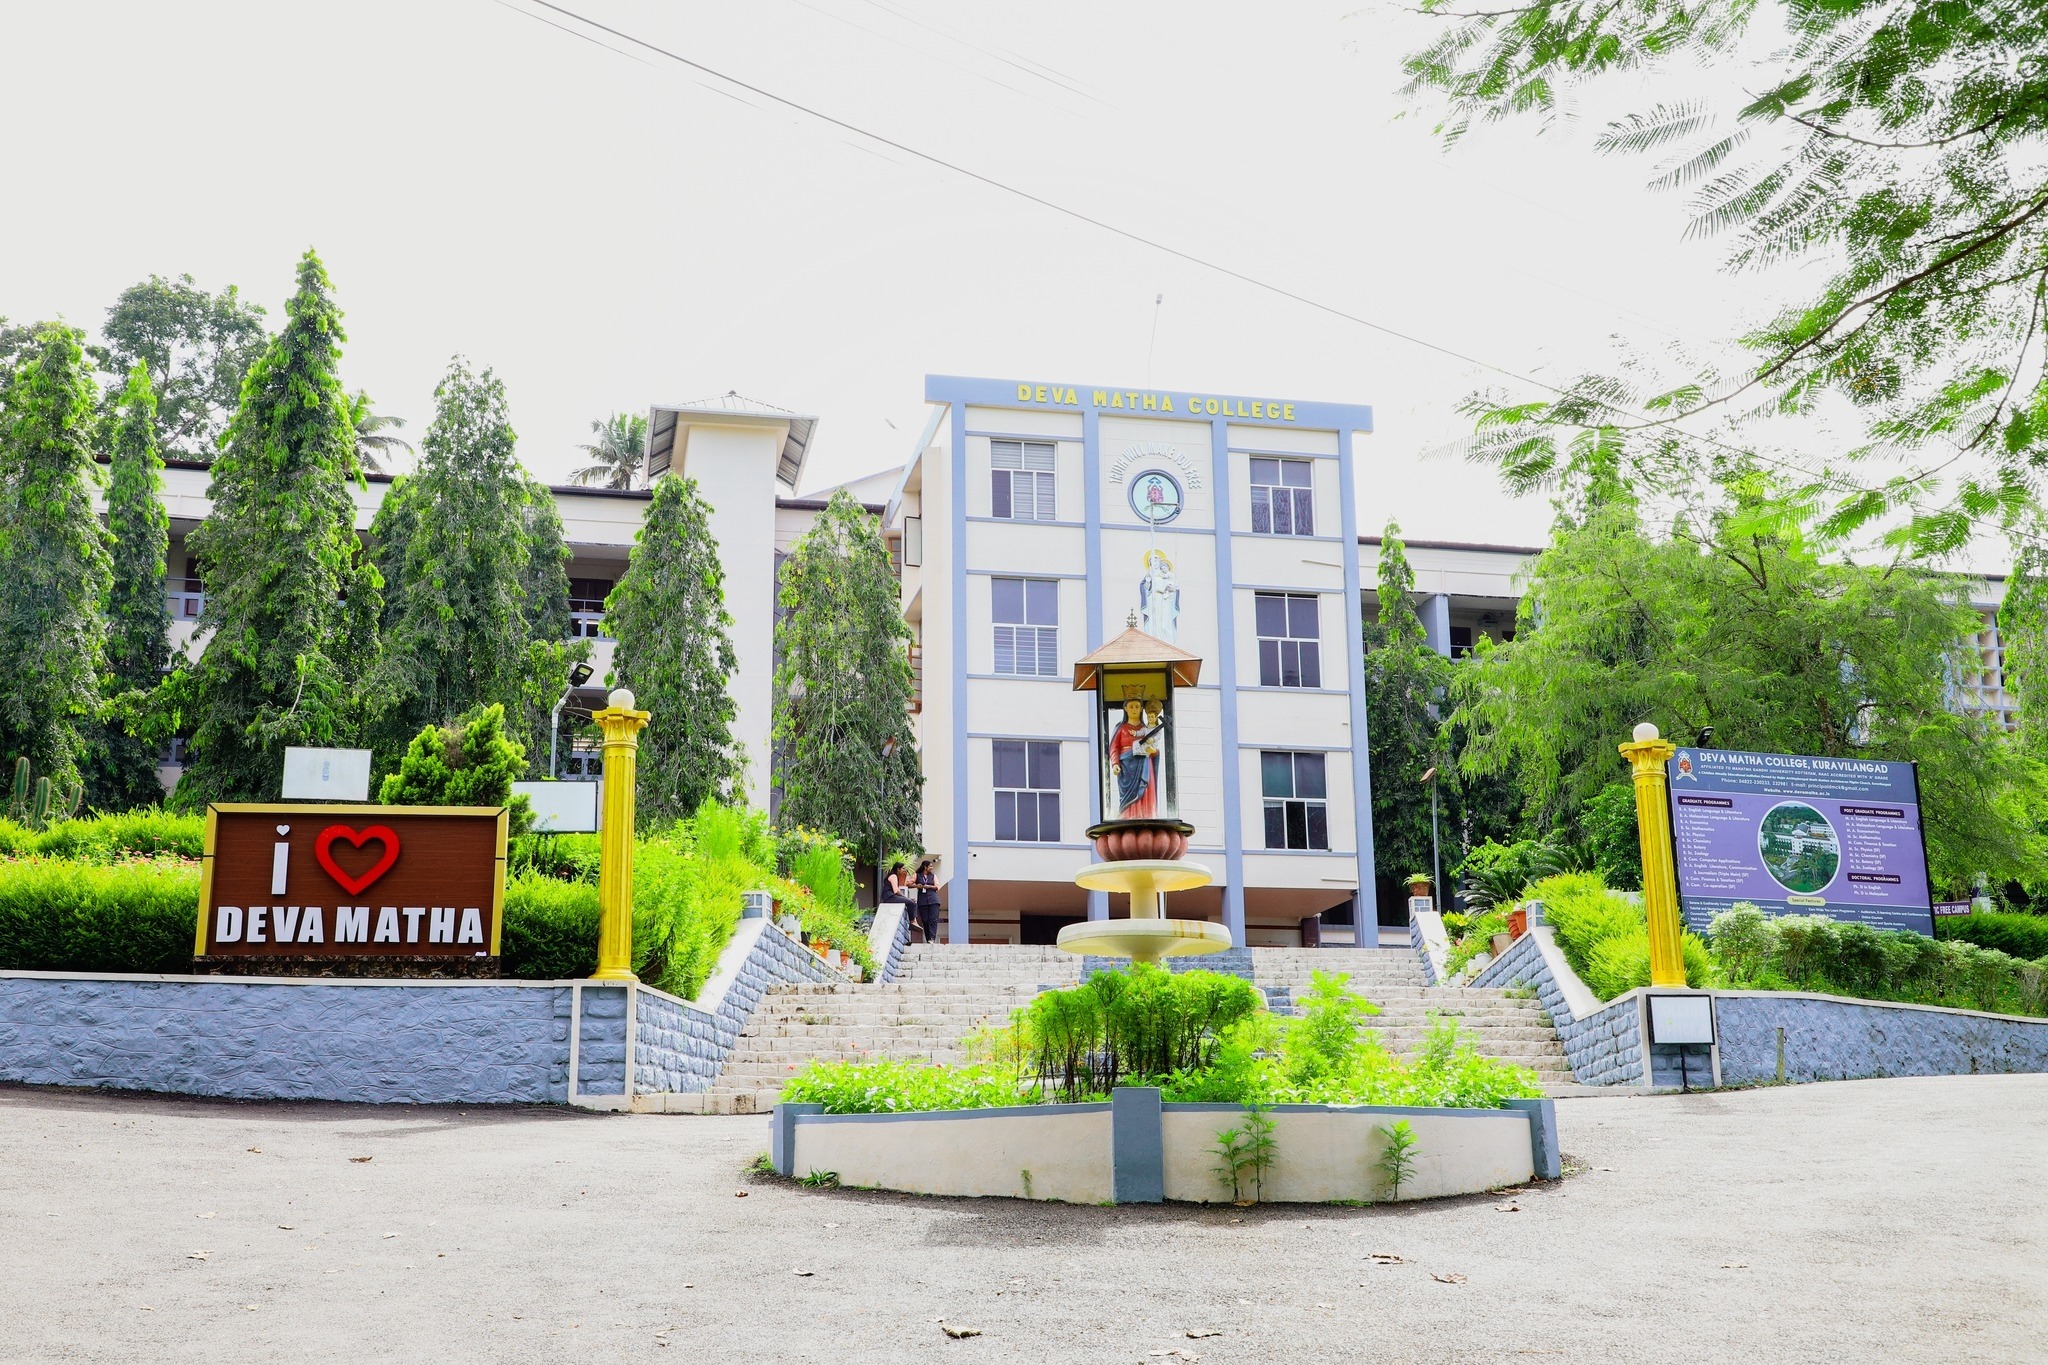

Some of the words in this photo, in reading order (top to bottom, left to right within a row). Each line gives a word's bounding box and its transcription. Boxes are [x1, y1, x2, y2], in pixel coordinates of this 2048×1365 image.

[1017, 384, 1079, 406] DEVA
[1093, 390, 1175, 413] MATHA
[1188, 397, 1296, 421] COLLEGE
[1700, 752, 1726, 763] DEVA
[1728, 754, 1763, 766] MATHA
[1765, 757, 1810, 770] COLLEGE,
[1812, 760, 1888, 774] KURAVILANGAD
[1940, 906, 1951, 914] FREE
[1952, 905, 1970, 914] CAMPUS
[215, 906, 324, 943] DEVA
[334, 906, 484, 944] MATHA
